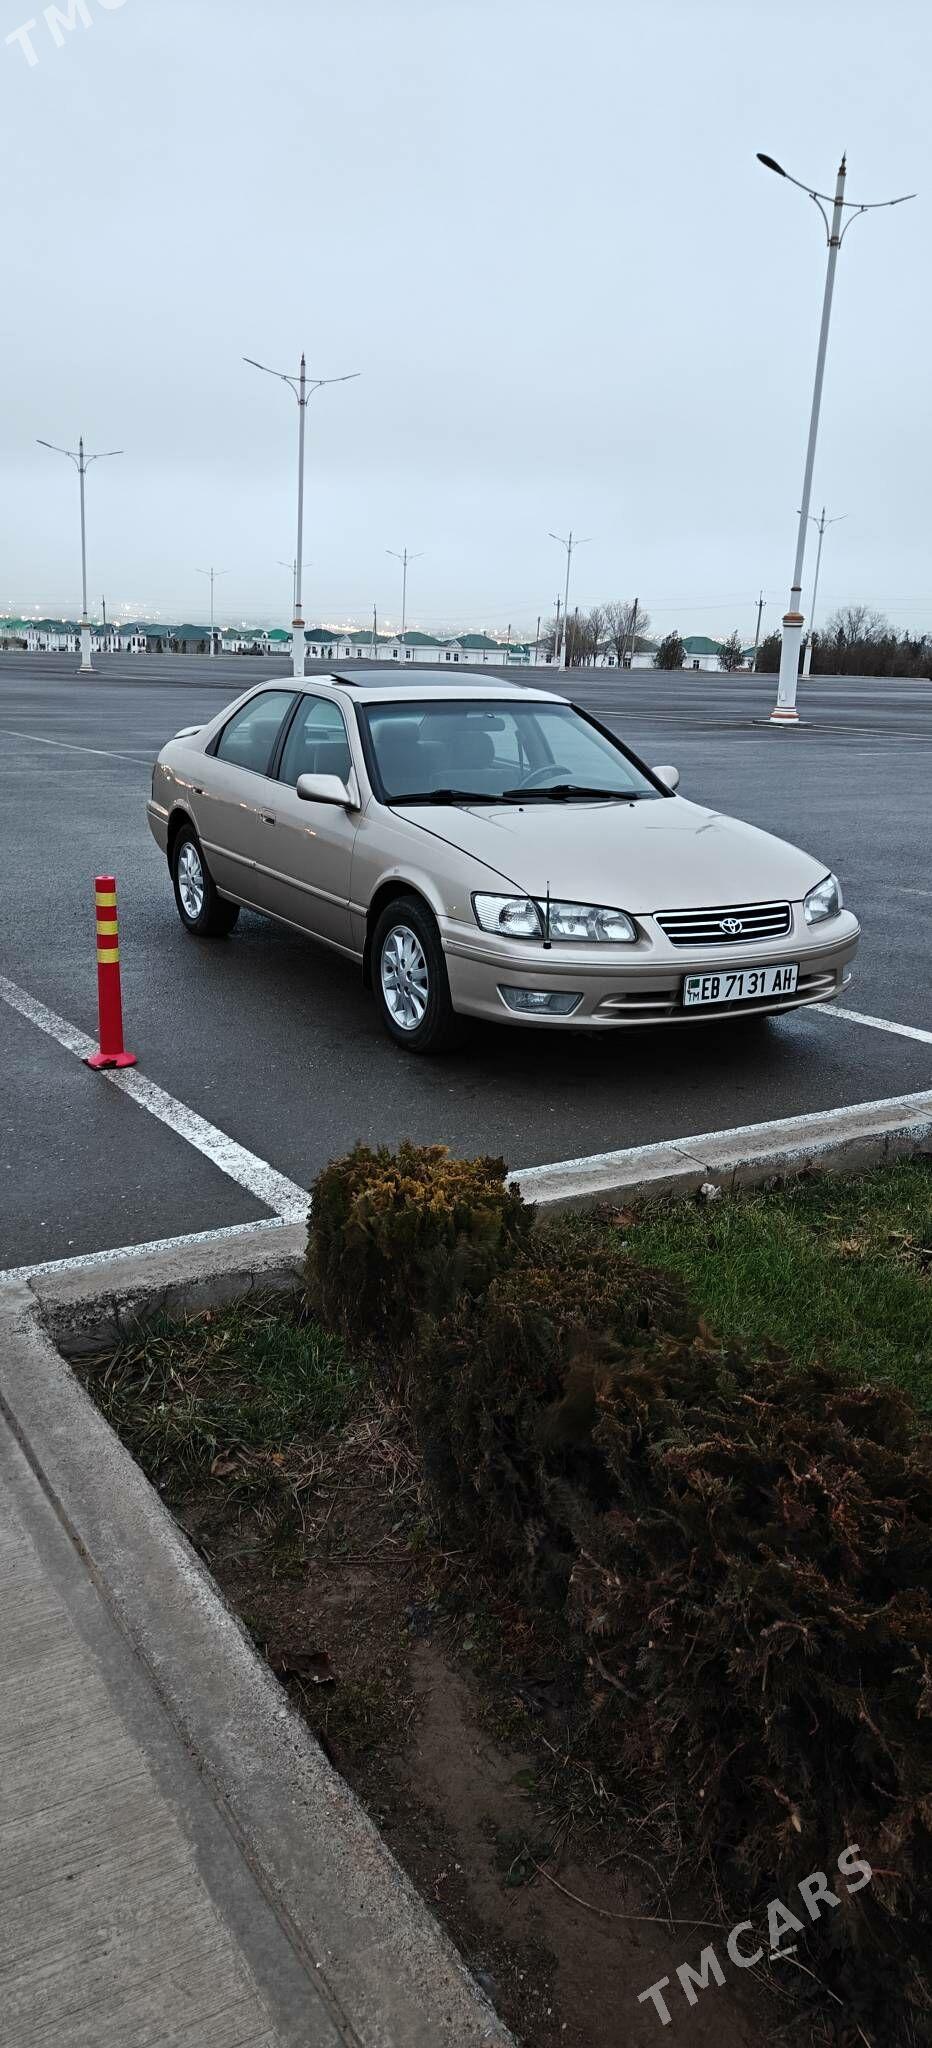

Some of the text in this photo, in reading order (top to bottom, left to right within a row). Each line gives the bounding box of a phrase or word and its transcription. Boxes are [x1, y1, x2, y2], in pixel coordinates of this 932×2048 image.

[701, 977, 720, 1000] EB
[772, 968, 793, 992] AH
[688, 991, 700, 1002] TM
